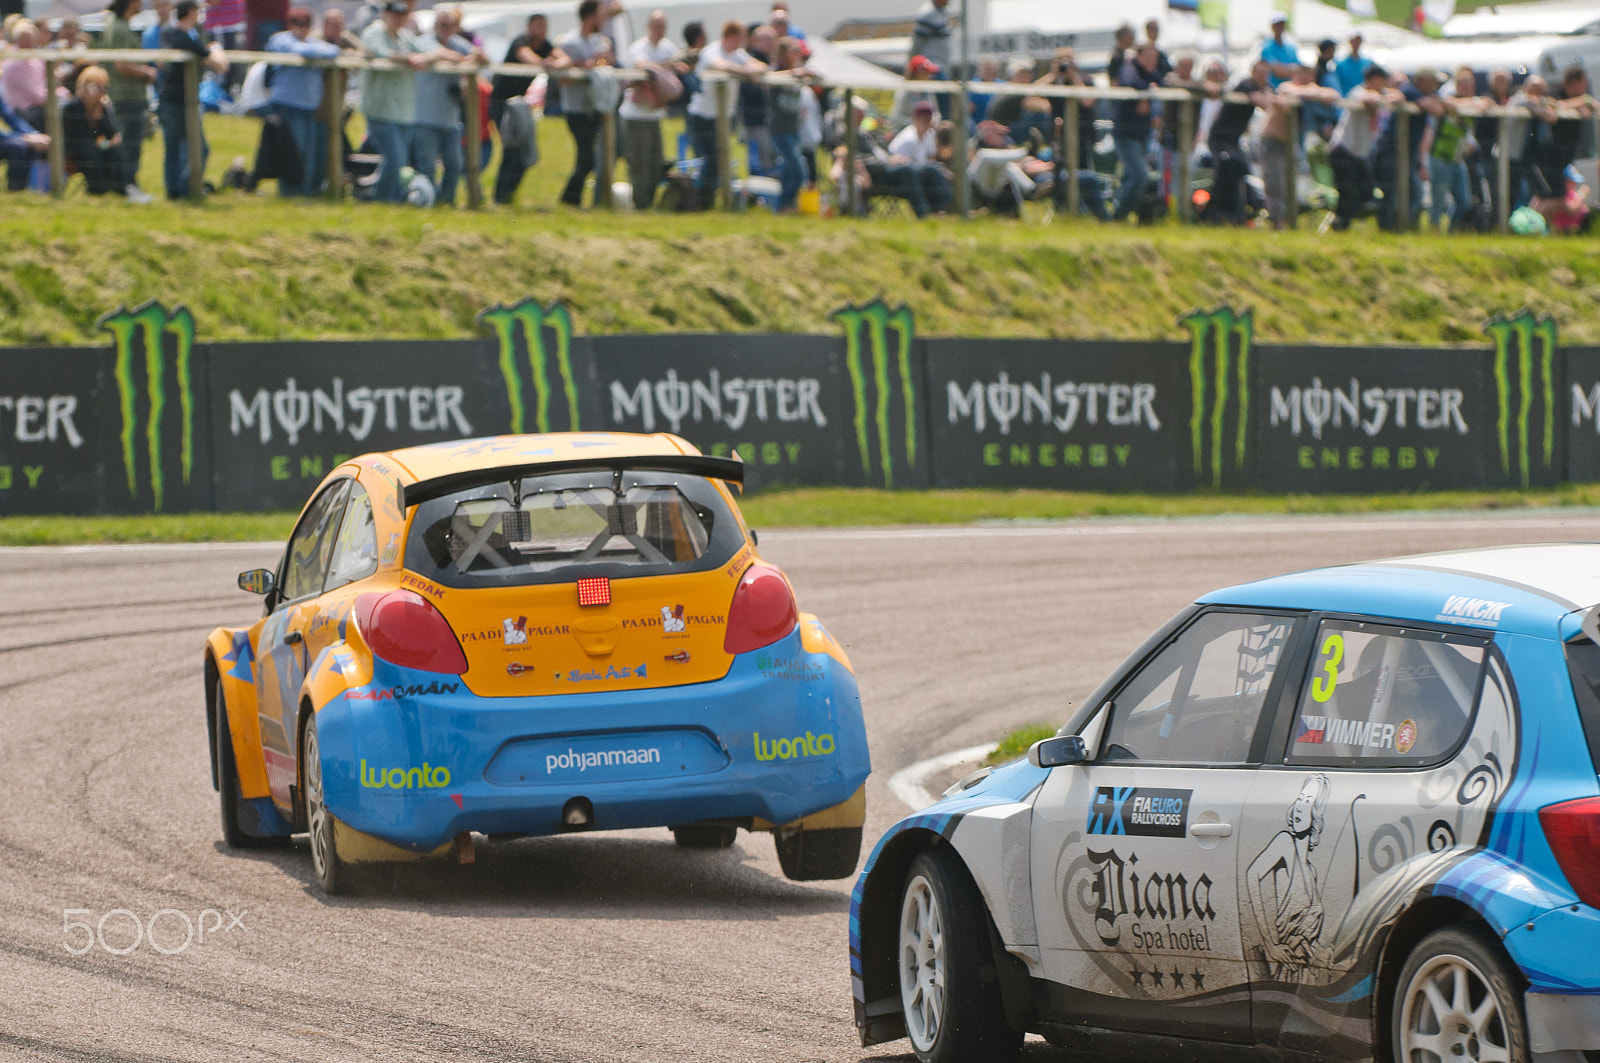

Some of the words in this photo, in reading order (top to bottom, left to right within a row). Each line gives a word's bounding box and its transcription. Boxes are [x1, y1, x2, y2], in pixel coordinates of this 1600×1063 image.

[229, 376, 472, 446] MONSTER
[609, 367, 828, 437] MONSTER
[946, 371, 1163, 434] MONSTER
[1269, 376, 1470, 439] MONSTER
[983, 442, 1131, 467] ENERGY
[1298, 445, 1440, 470] ENERGY
[402, 575, 446, 599] FEDAK
[461, 630, 502, 642] PAADI
[528, 625, 570, 637] PAGAR
[621, 617, 662, 629] PAADI
[686, 615, 725, 625] PAGAR
[1311, 634, 1345, 703] 3
[753, 731, 836, 761] luonto
[1325, 717, 1396, 749] VIMMER
[360, 758, 450, 789] luonto
[546, 747, 661, 774] pohjanmaan
[1131, 812, 1181, 826] RALLYCROSS
[1086, 846, 1217, 947] Diana
[1131, 922, 1165, 957] Spa
[1166, 923, 1212, 951] hotel
